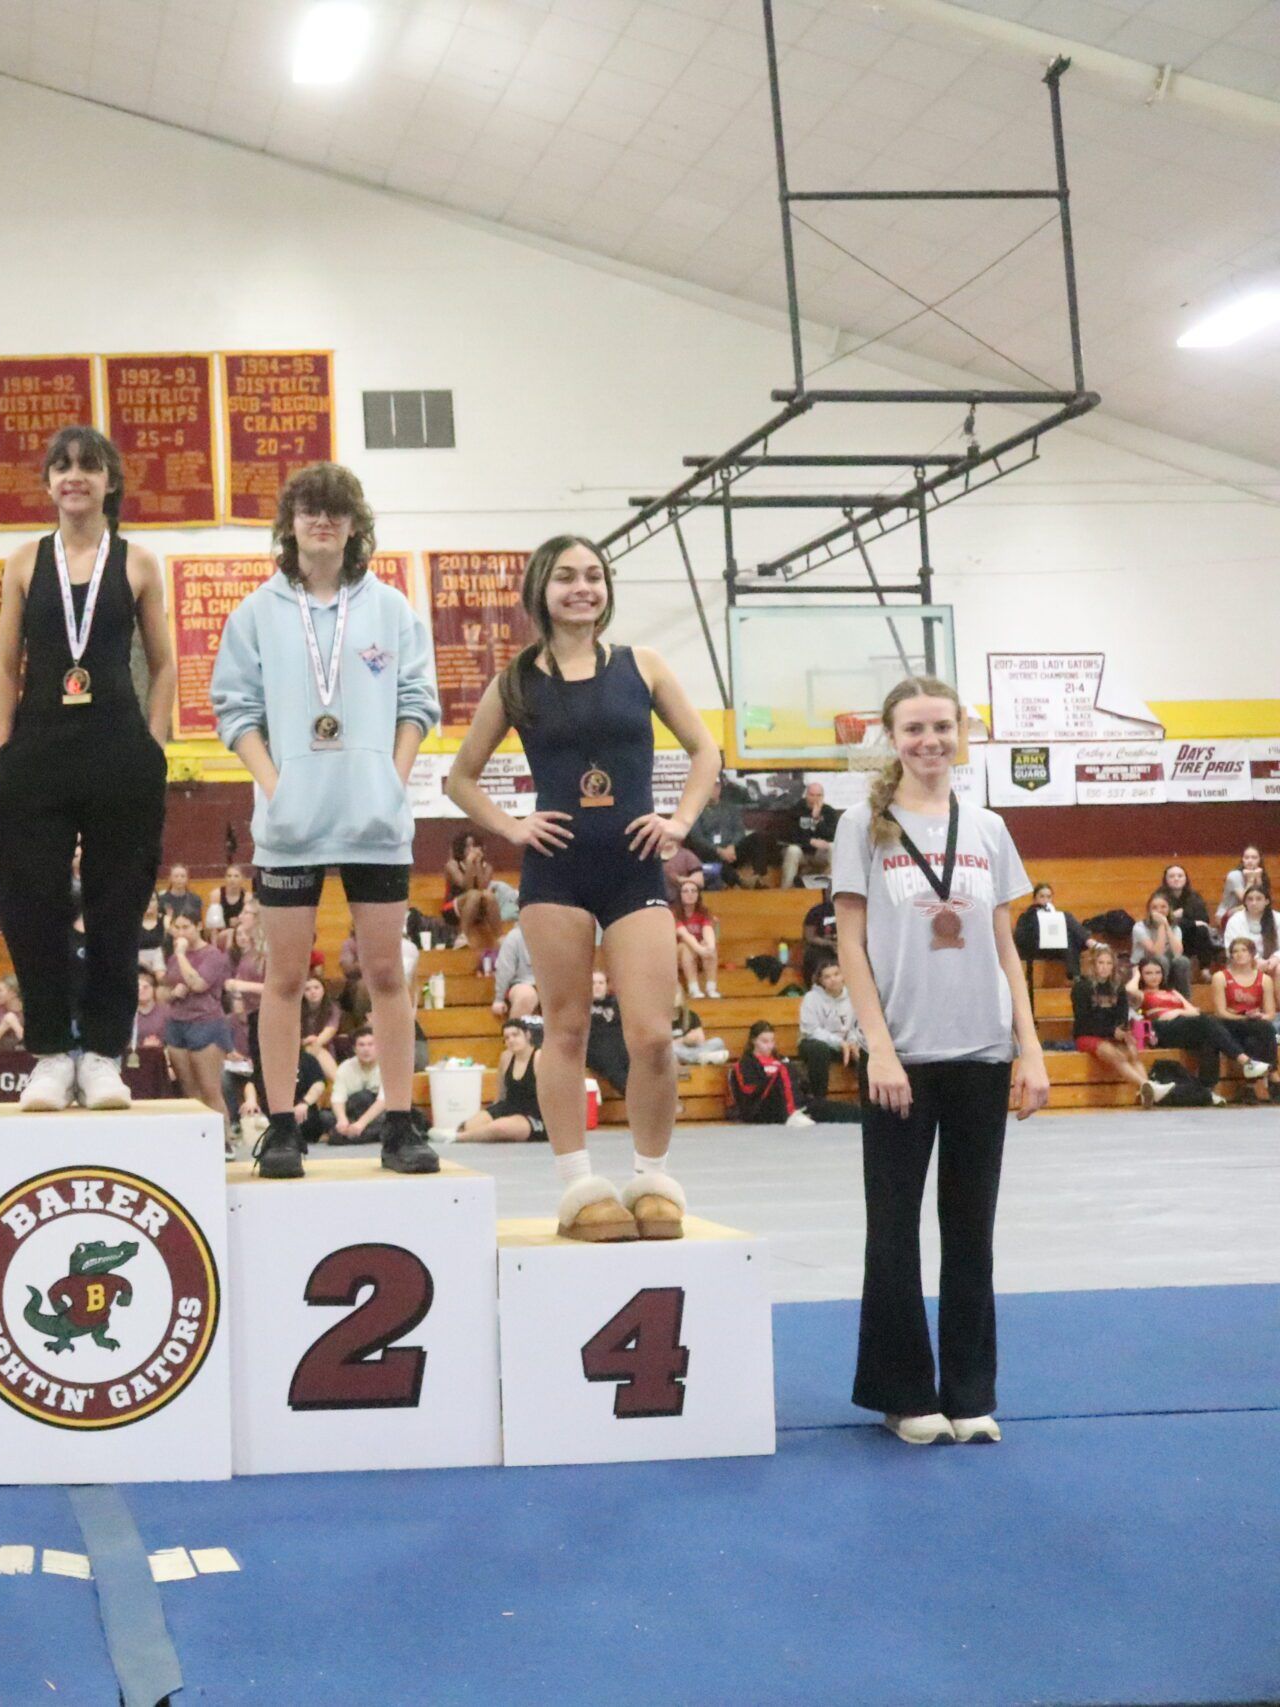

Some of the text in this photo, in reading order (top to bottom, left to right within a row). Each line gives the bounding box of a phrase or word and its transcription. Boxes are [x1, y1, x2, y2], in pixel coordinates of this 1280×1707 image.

[241, 356, 314, 375] 1994-95
[3, 374, 75, 393] 1991-92
[121, 367, 196, 385] 1992-93
[236, 376, 320, 394] DISTRICT
[117, 386, 200, 404] DISTRICT
[229, 395, 330, 413] SUB-REGION
[4, 413, 79, 431] CHAMPS
[122, 405, 198, 423] CHAMPS
[243, 414, 318, 432] CHAMPS
[20, 433, 47, 451] 19-
[255, 436, 305, 455] 20-7
[442, 575, 515, 590] DISTRICT
[182, 598, 204, 615] 2A
[437, 592, 459, 607] 2A
[994, 659, 1100, 670] 2017-2018 LADY GATORS
[1008, 672, 1038, 680] DISTRICT
[1040, 672, 1078, 680] CHAMPIONS
[1064, 683, 1085, 693] 21-4
[1015, 755, 1046, 765] ARMY
[1015, 769, 1047, 779] GUARD
[1171, 761, 1245, 780] TIRE PROS
[1, 1180, 170, 1239] BAKER
[86, 1284, 105, 1312] B
[288, 1242, 434, 1411] 2
[108, 1297, 201, 1408] GATORS
[581, 1286, 690, 1419] 4
